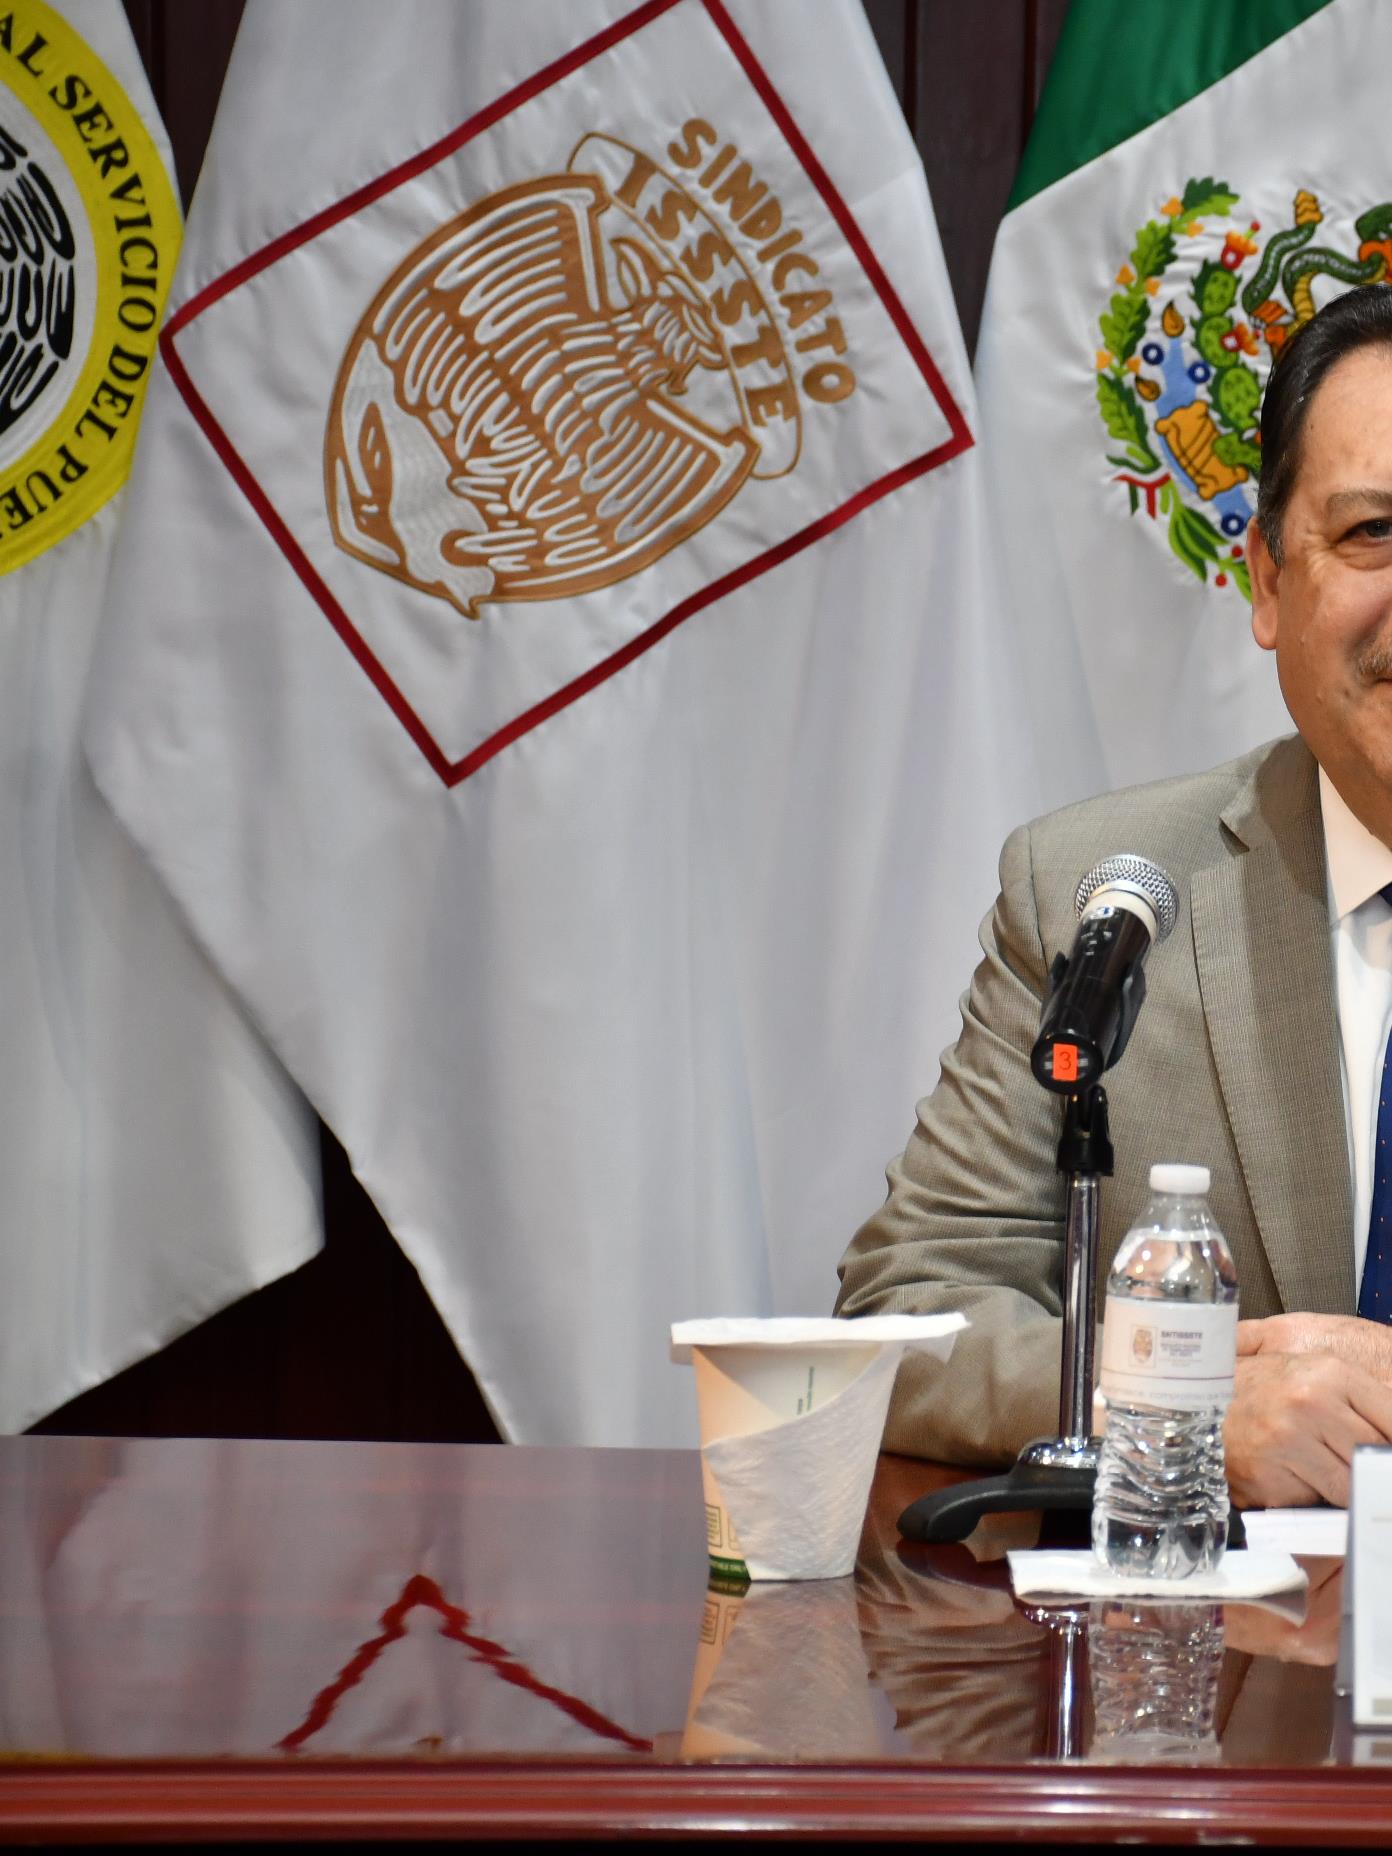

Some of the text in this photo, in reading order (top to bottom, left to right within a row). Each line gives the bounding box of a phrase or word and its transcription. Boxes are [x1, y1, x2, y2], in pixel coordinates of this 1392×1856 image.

[48, 73, 158, 333] SERVICIO
[615, 154, 799, 428] ISSSTE
[667, 118, 856, 404] SINDICATO
[74, 341, 148, 443] DEL
[0, 444, 89, 540] PUE
[1059, 1051, 1072, 1070] 3
